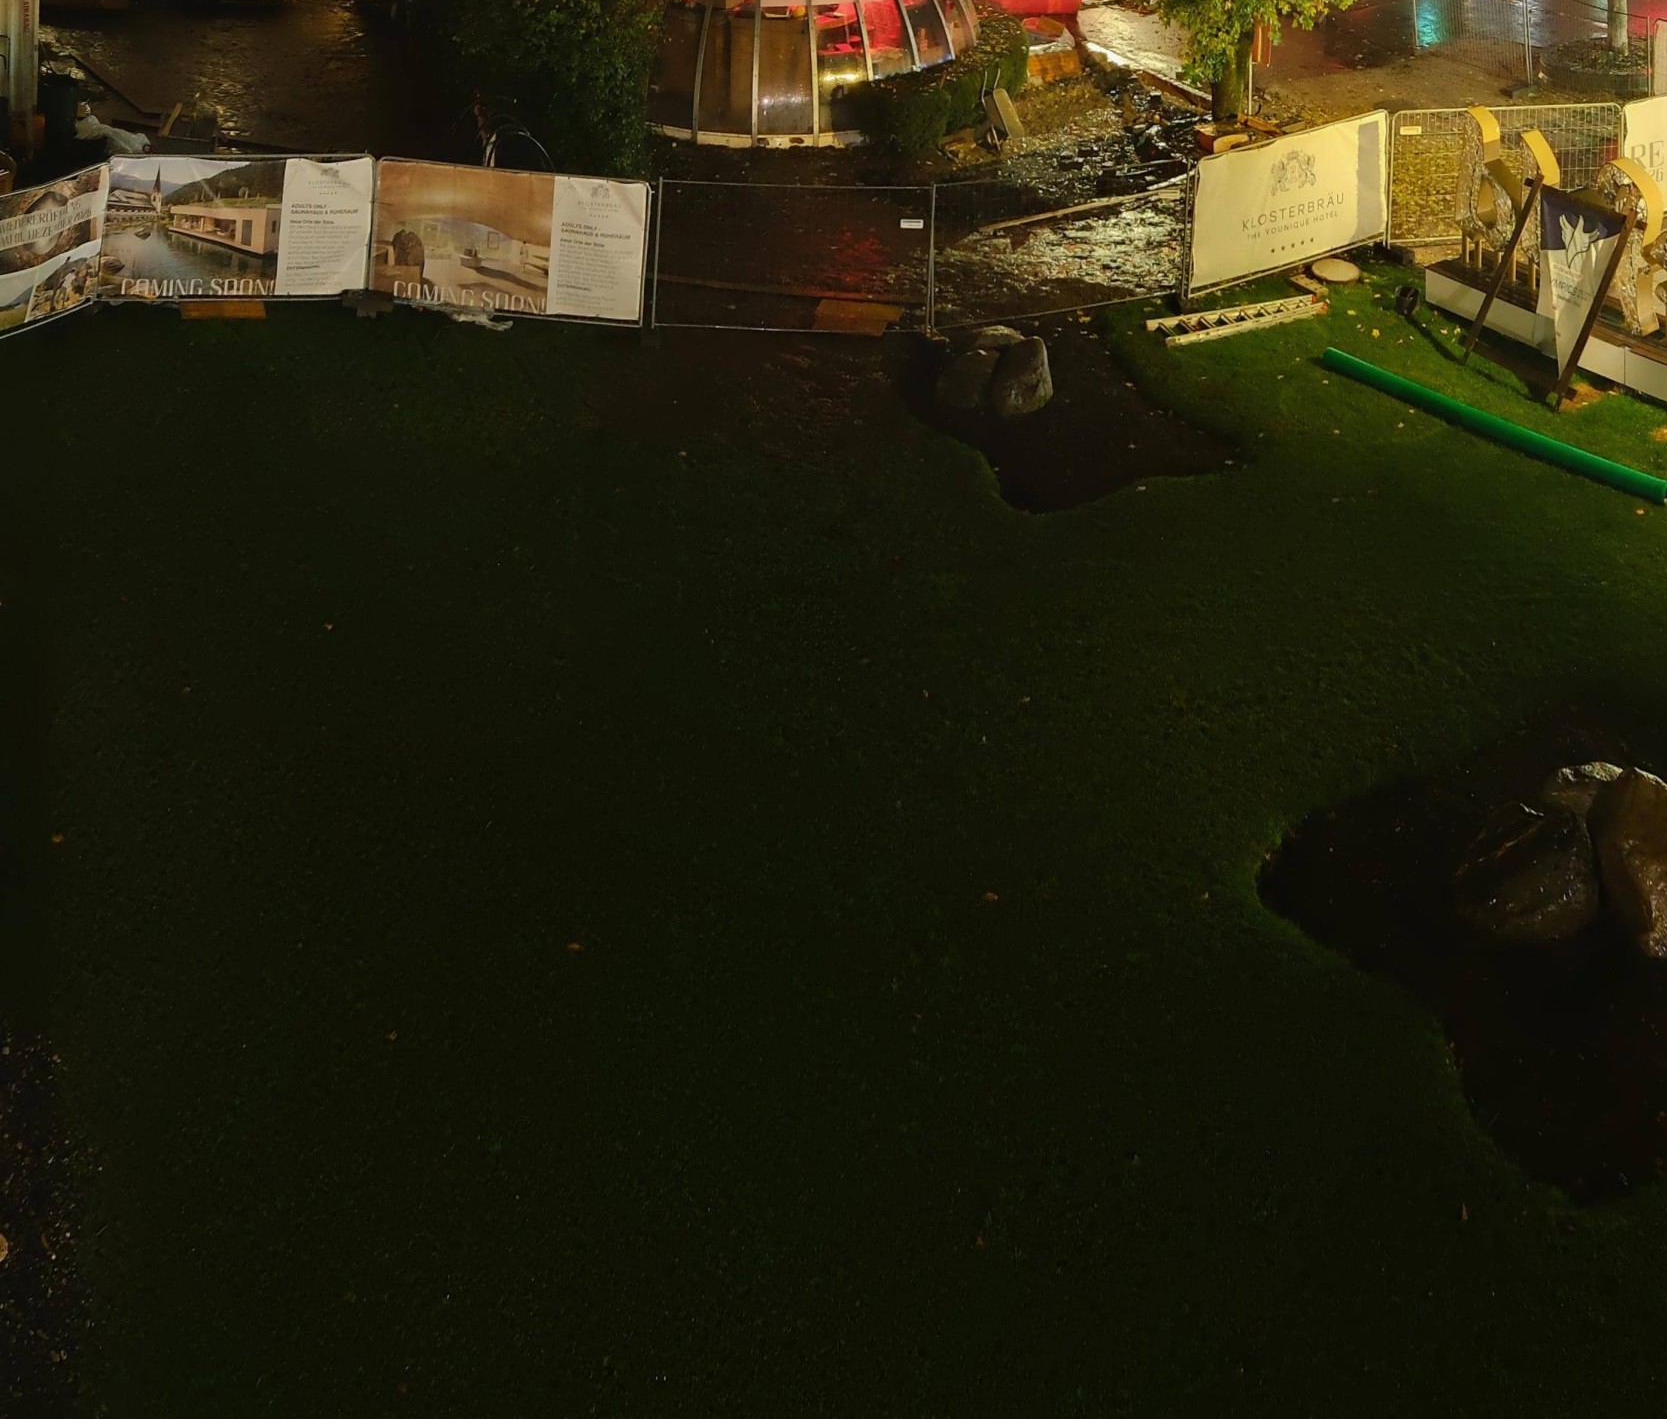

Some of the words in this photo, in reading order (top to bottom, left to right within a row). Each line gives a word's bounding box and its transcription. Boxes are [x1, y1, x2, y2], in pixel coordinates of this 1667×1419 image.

[1242, 191, 1345, 232] KLOSTERBRÄU
[1246, 230, 1261, 242] THE
[1265, 217, 1310, 237] YOUNIQUE
[1313, 210, 1339, 224] HOTEL
[393, 280, 475, 304] COMING
